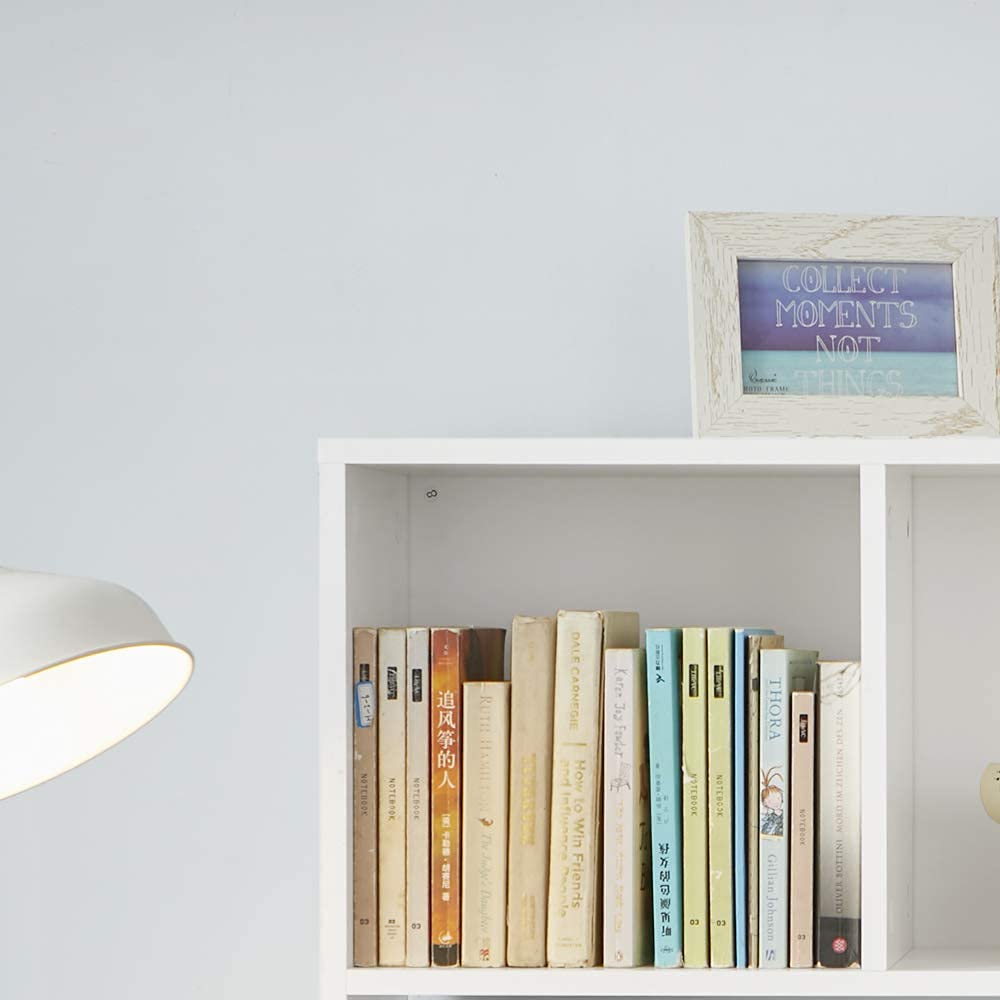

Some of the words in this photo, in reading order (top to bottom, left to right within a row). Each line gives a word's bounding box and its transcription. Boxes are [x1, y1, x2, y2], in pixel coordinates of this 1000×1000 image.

[782, 264, 906, 294] COLLECT
[775, 299, 918, 329] MOMENTS
[815, 335, 881, 363] NOT
[796, 370, 903, 396] THINGS
[571, 631, 581, 664] DALE
[569, 667, 580, 732] CARNEGIE
[769, 677, 783, 742] THORA
[437, 691, 456, 790] 追风筝的人
[574, 760, 586, 792] How
[574, 798, 585, 813] to
[690, 774, 698, 817] NOTEBOOK
[716, 775, 724, 818] NOTEBOOK
[573, 818, 585, 848] Win
[768, 854, 778, 893] Gillian
[835, 839, 843, 878] BOTTINI
[571, 853, 584, 909] Friends
[835, 881, 843, 914] OLIVER
[766, 896, 778, 941] Johnson
